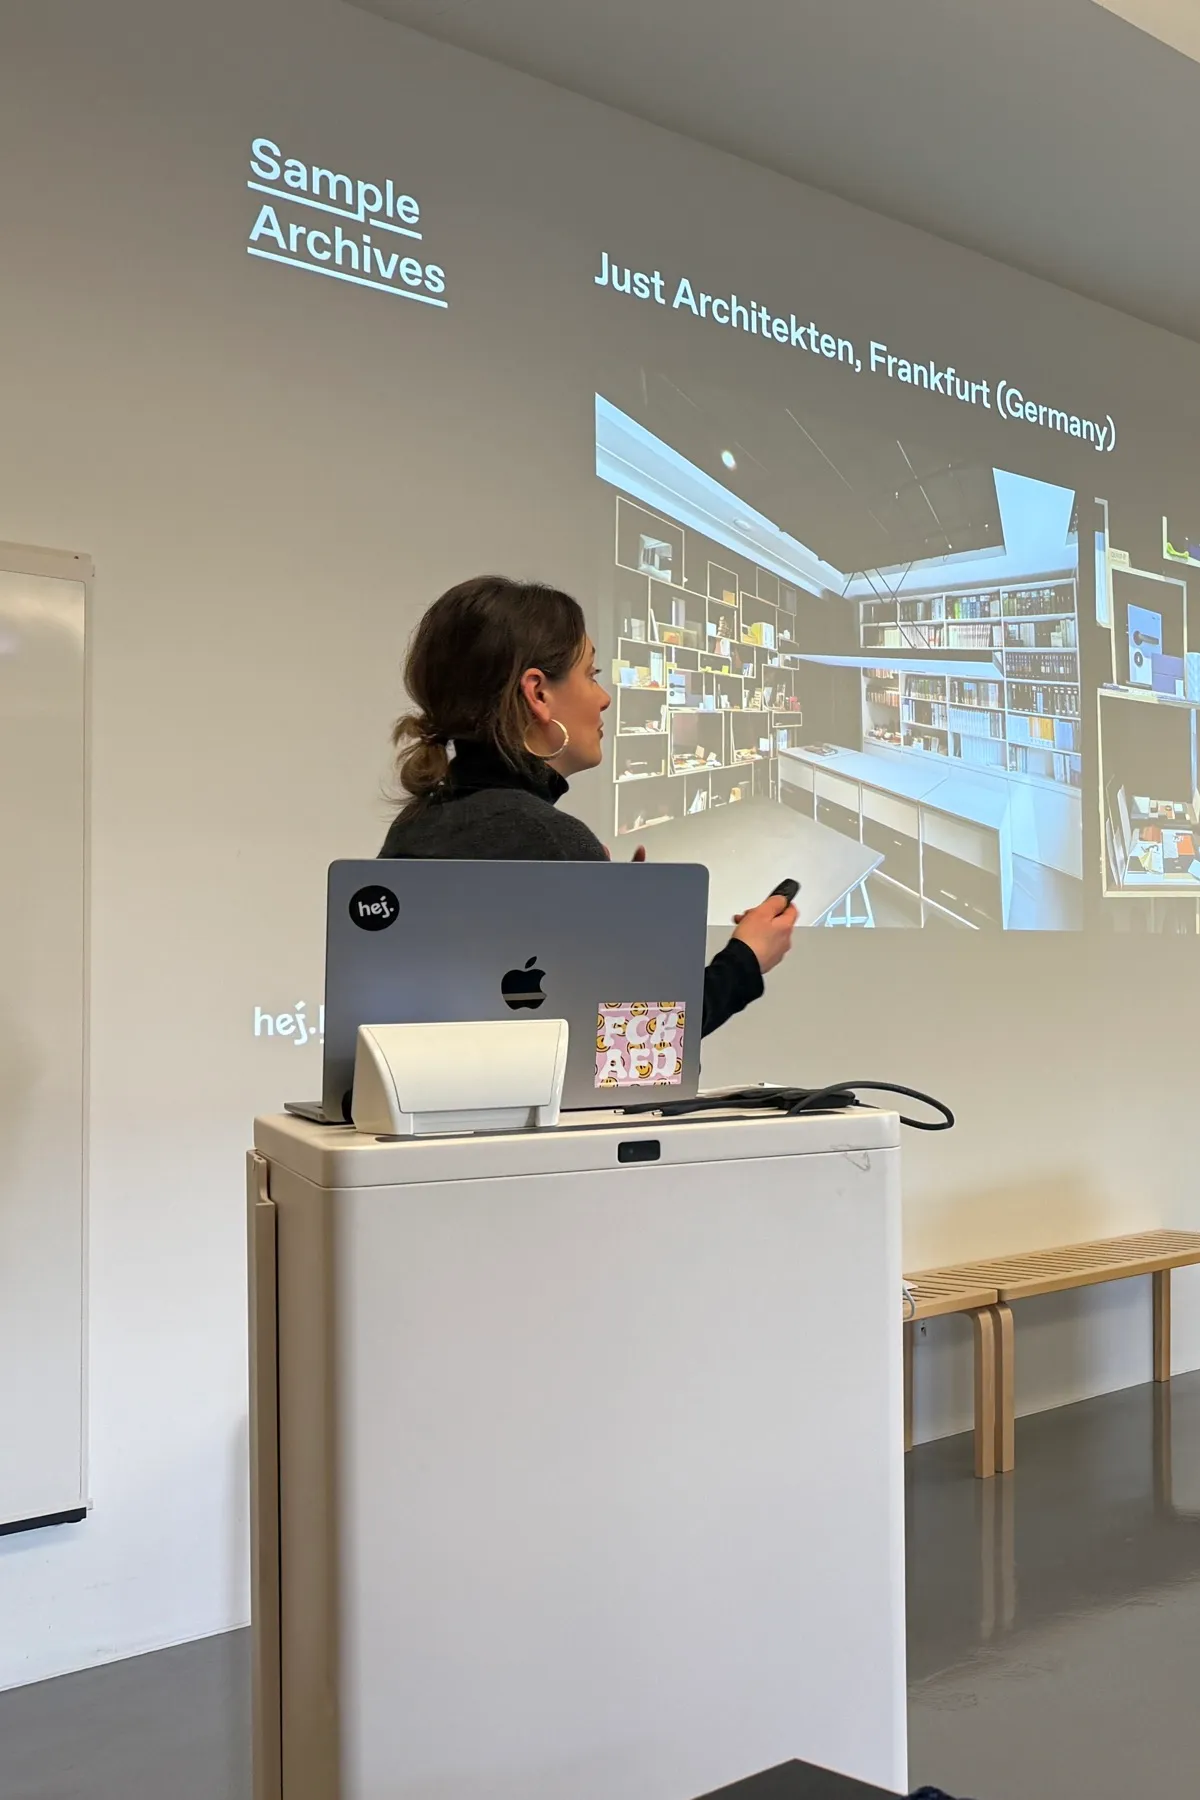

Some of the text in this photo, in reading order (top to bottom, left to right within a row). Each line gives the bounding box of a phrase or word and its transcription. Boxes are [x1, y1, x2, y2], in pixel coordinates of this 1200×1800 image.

[249, 138, 421, 224] Sample
[248, 204, 448, 295] Archives
[594, 252, 1117, 453] Just Architekten, Frankfurt (Germany)
[358, 895, 395, 919] hej.
[603, 1013, 678, 1048] FCK
